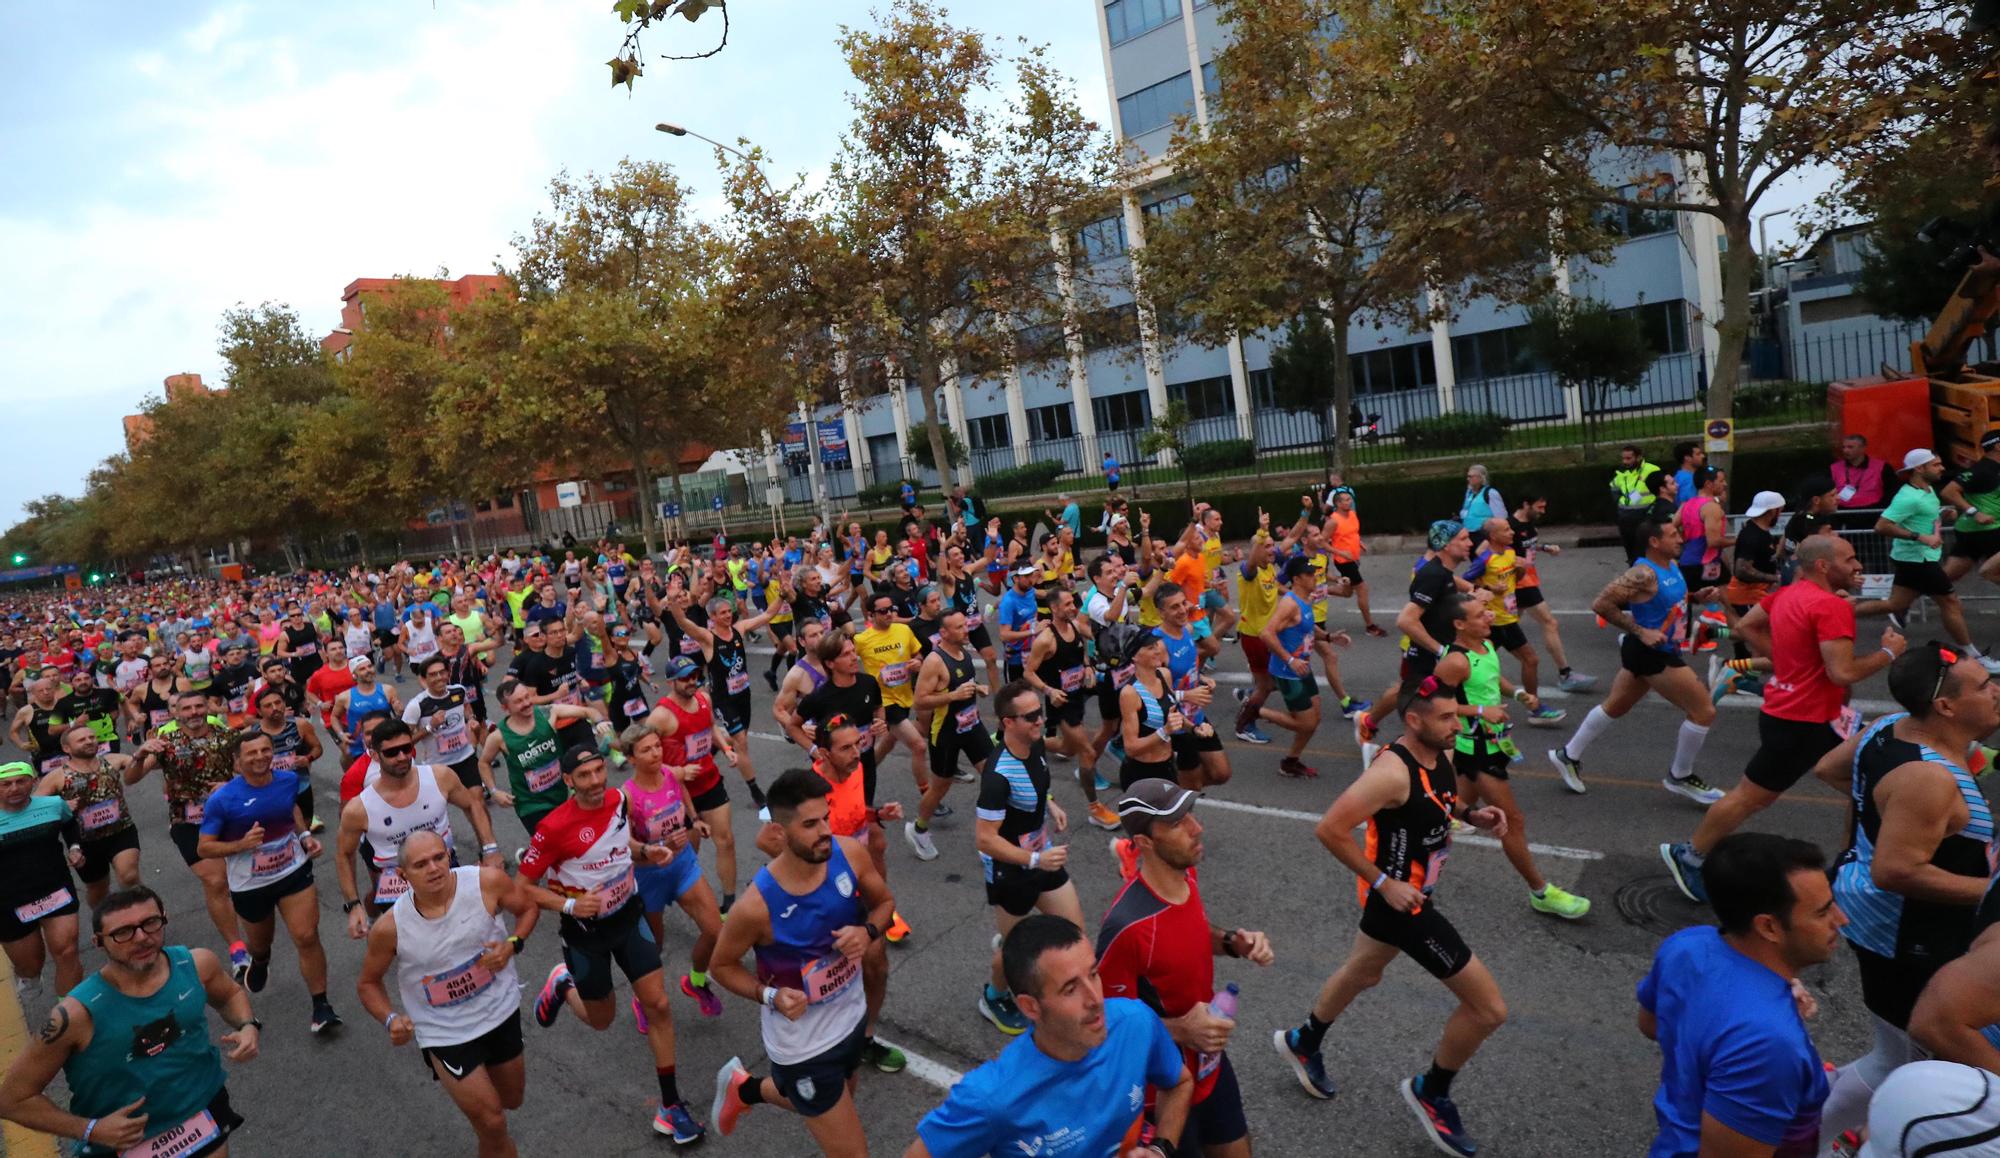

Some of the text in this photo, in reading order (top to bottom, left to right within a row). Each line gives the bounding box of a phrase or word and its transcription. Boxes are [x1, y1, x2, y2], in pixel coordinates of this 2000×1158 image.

[517, 738, 555, 762] BOSTON
[92, 813, 114, 824] Pablo
[386, 831, 407, 842] CLUB
[446, 971, 473, 990] 4543
[819, 964, 857, 996] Beltrán
[448, 981, 477, 1000] Rafa
[151, 1124, 186, 1152] 4900
